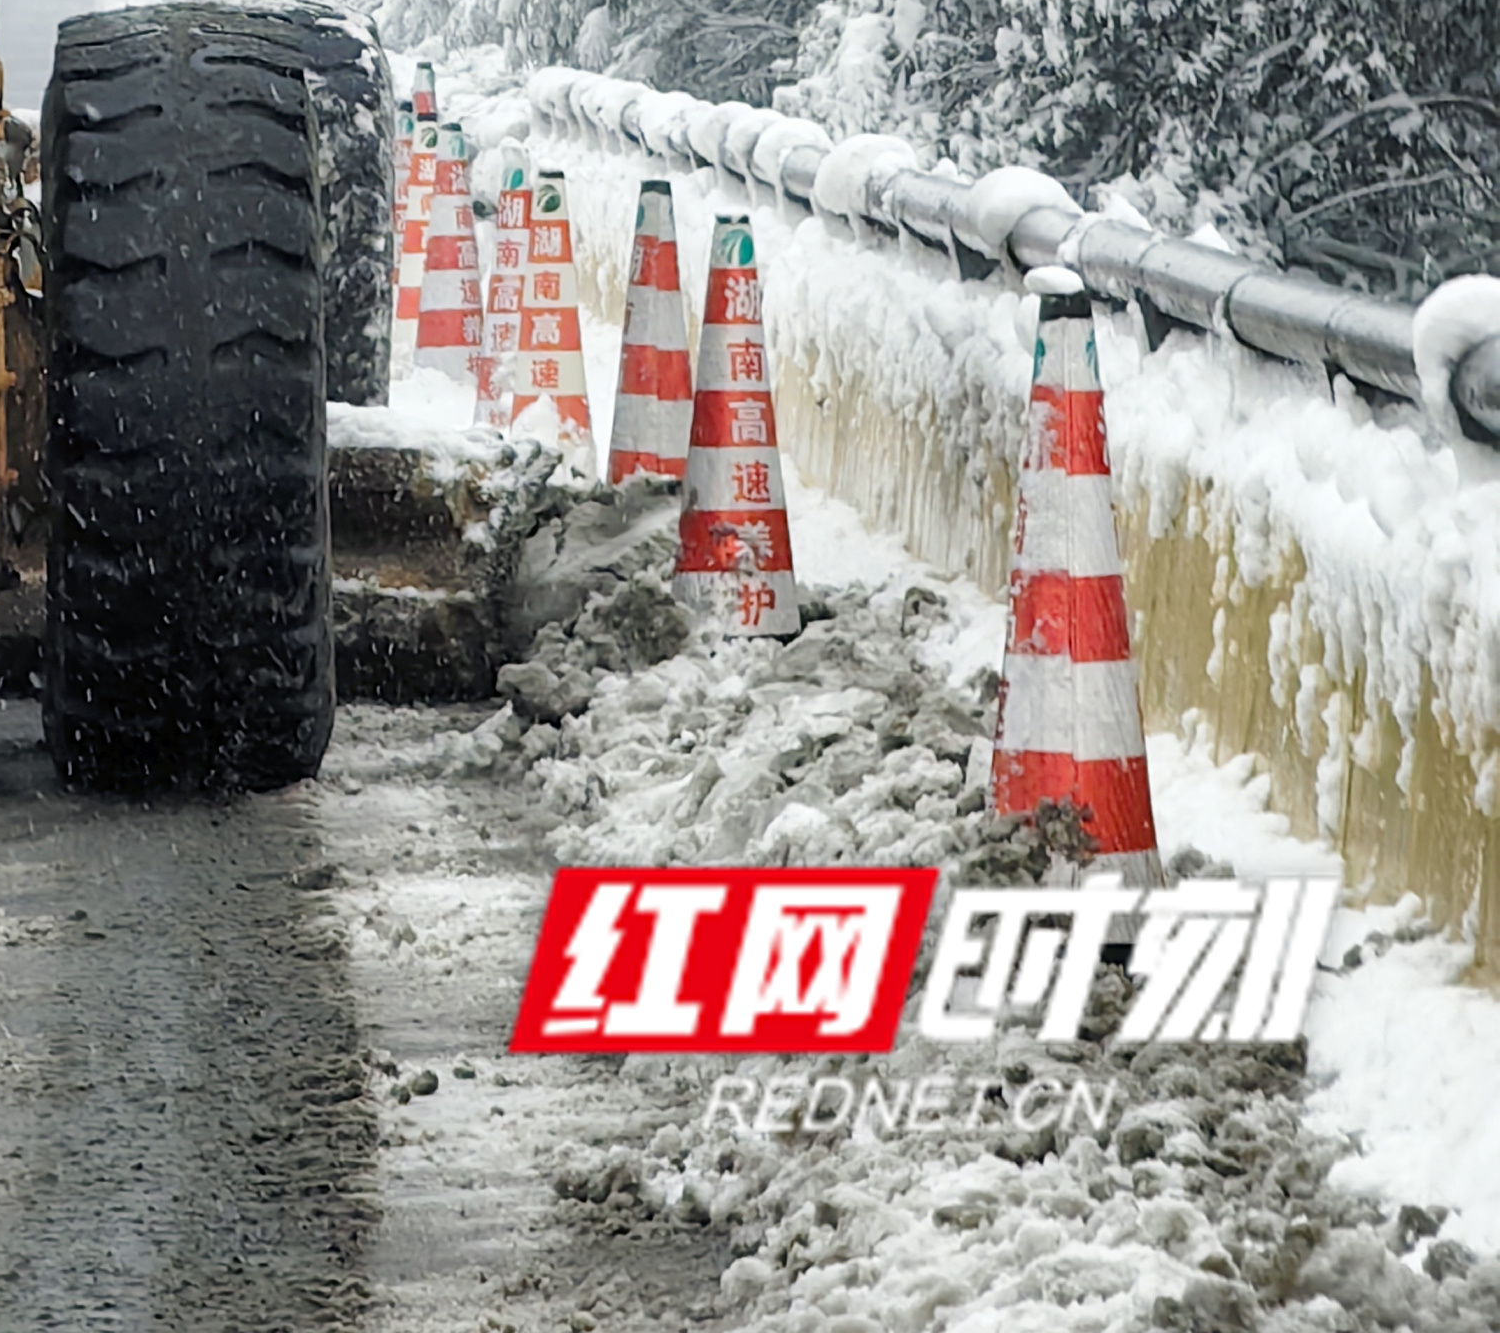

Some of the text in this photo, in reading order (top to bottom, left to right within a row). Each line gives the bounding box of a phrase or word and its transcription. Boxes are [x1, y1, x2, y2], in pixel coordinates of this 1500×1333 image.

[724, 275, 776, 627] 湖南高速养护
